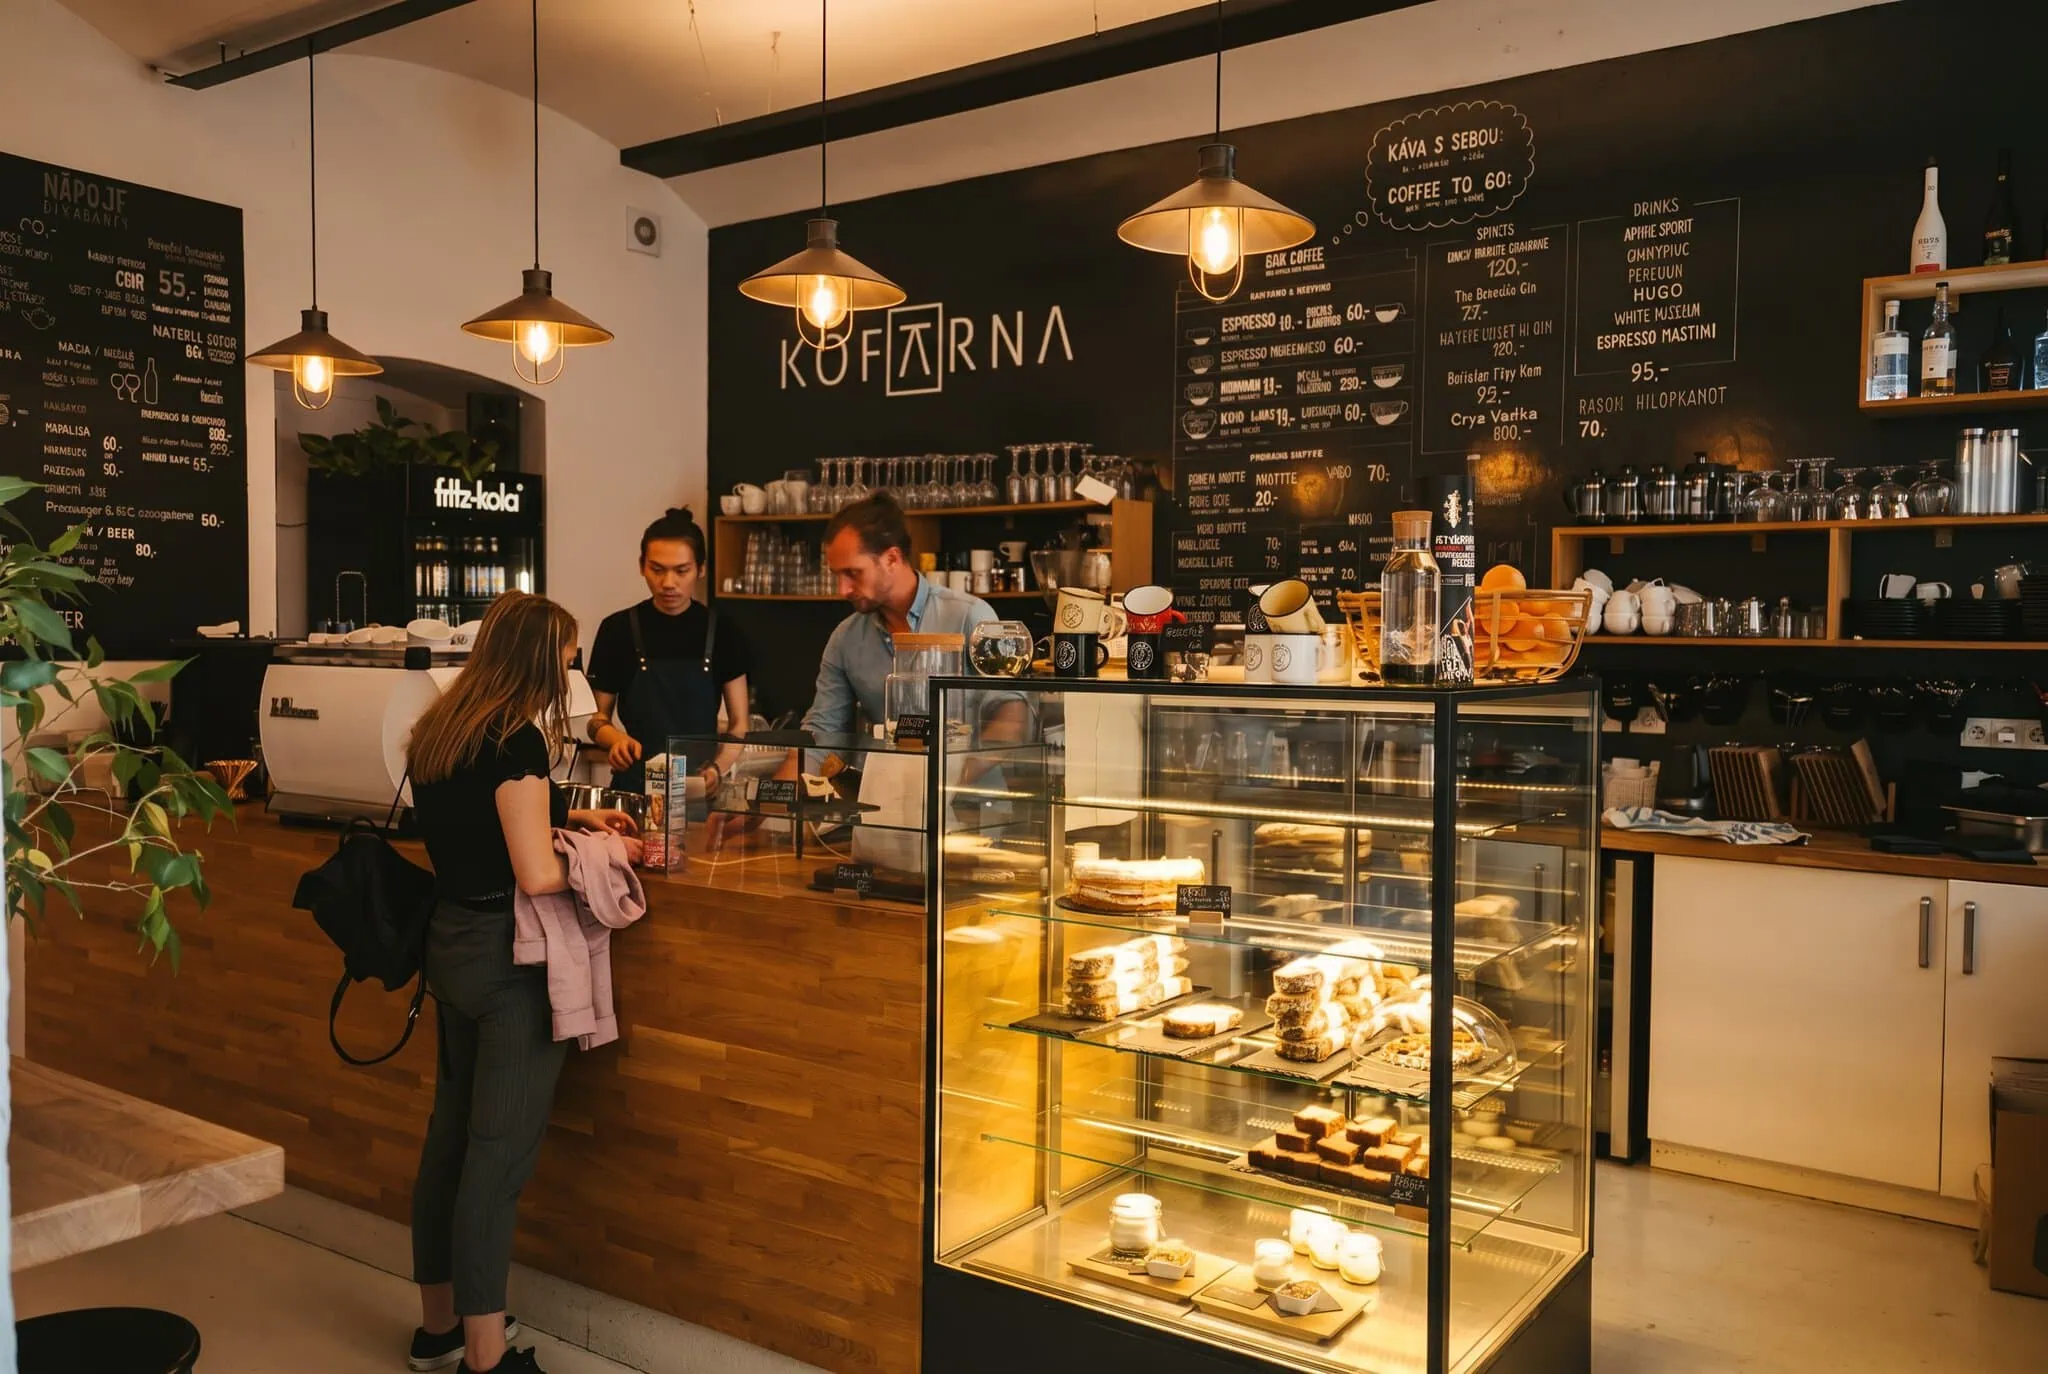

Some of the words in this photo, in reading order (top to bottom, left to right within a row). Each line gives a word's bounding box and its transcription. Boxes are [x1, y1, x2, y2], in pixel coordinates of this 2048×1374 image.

[1387, 135, 1428, 163] KÁVA
[1433, 135, 1445, 155] S
[1387, 180, 1442, 205] COFFEE
[1450, 175, 1473, 195] TO
[1633, 197, 1680, 217] DRINKS
[1289, 246, 1325, 264] COFFEE
[1455, 289, 1473, 303] The
[1633, 282, 1683, 303] HUGO
[1221, 311, 1277, 334] ESPRESSO
[1613, 308, 1651, 327] WHITE
[1596, 329, 1657, 350] ESPRESSO
[1221, 346, 1268, 364] ESPRESSO
[107, 526, 136, 541] BEER
